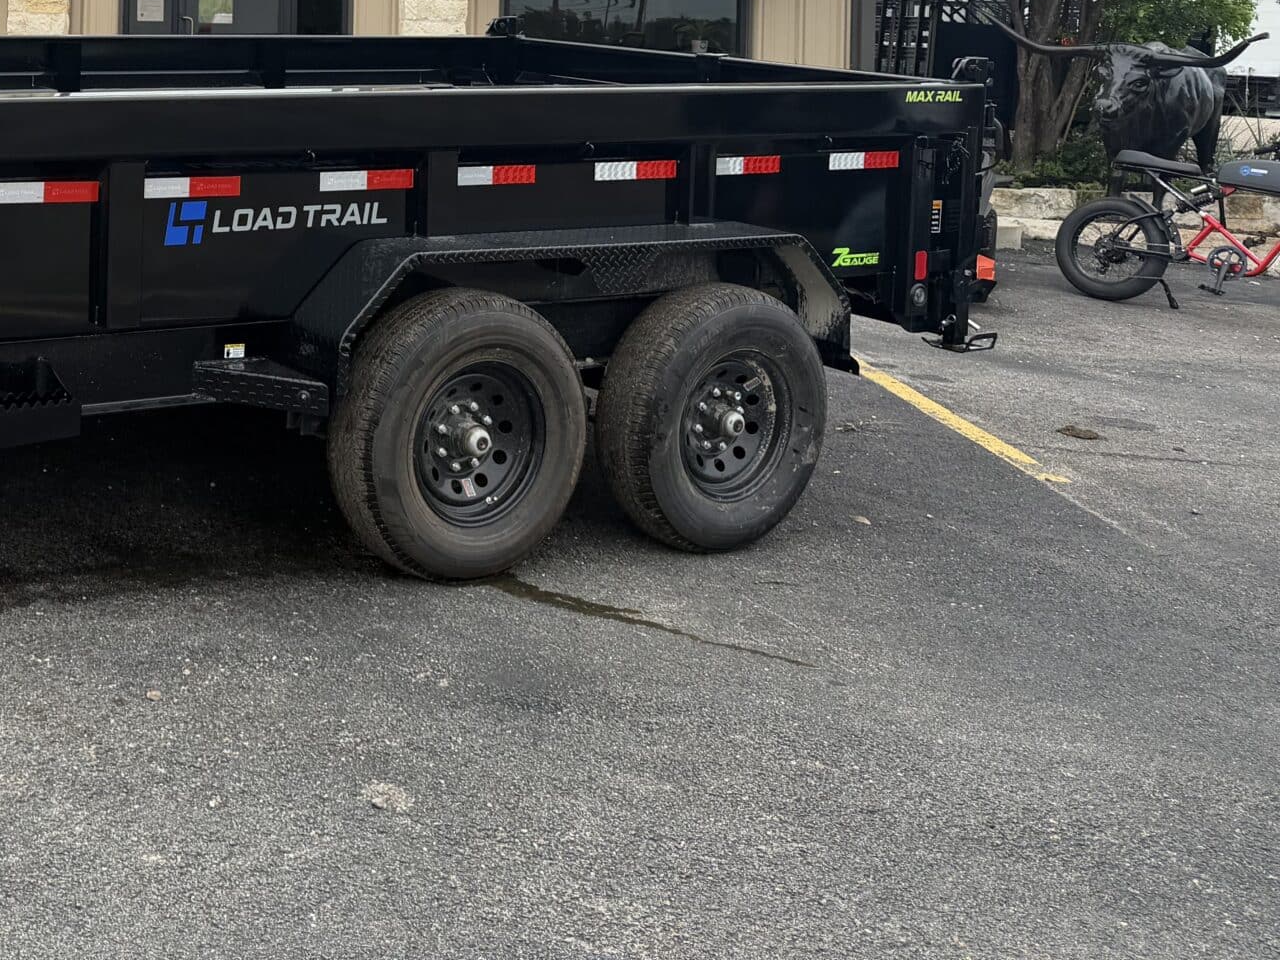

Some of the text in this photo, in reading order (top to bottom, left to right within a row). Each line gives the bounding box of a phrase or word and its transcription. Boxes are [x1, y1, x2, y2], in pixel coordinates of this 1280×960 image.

[905, 90, 963, 102] MAX RAIL
[212, 202, 388, 233] LOAD TRAIL
[840, 255, 879, 267] GAUGE
